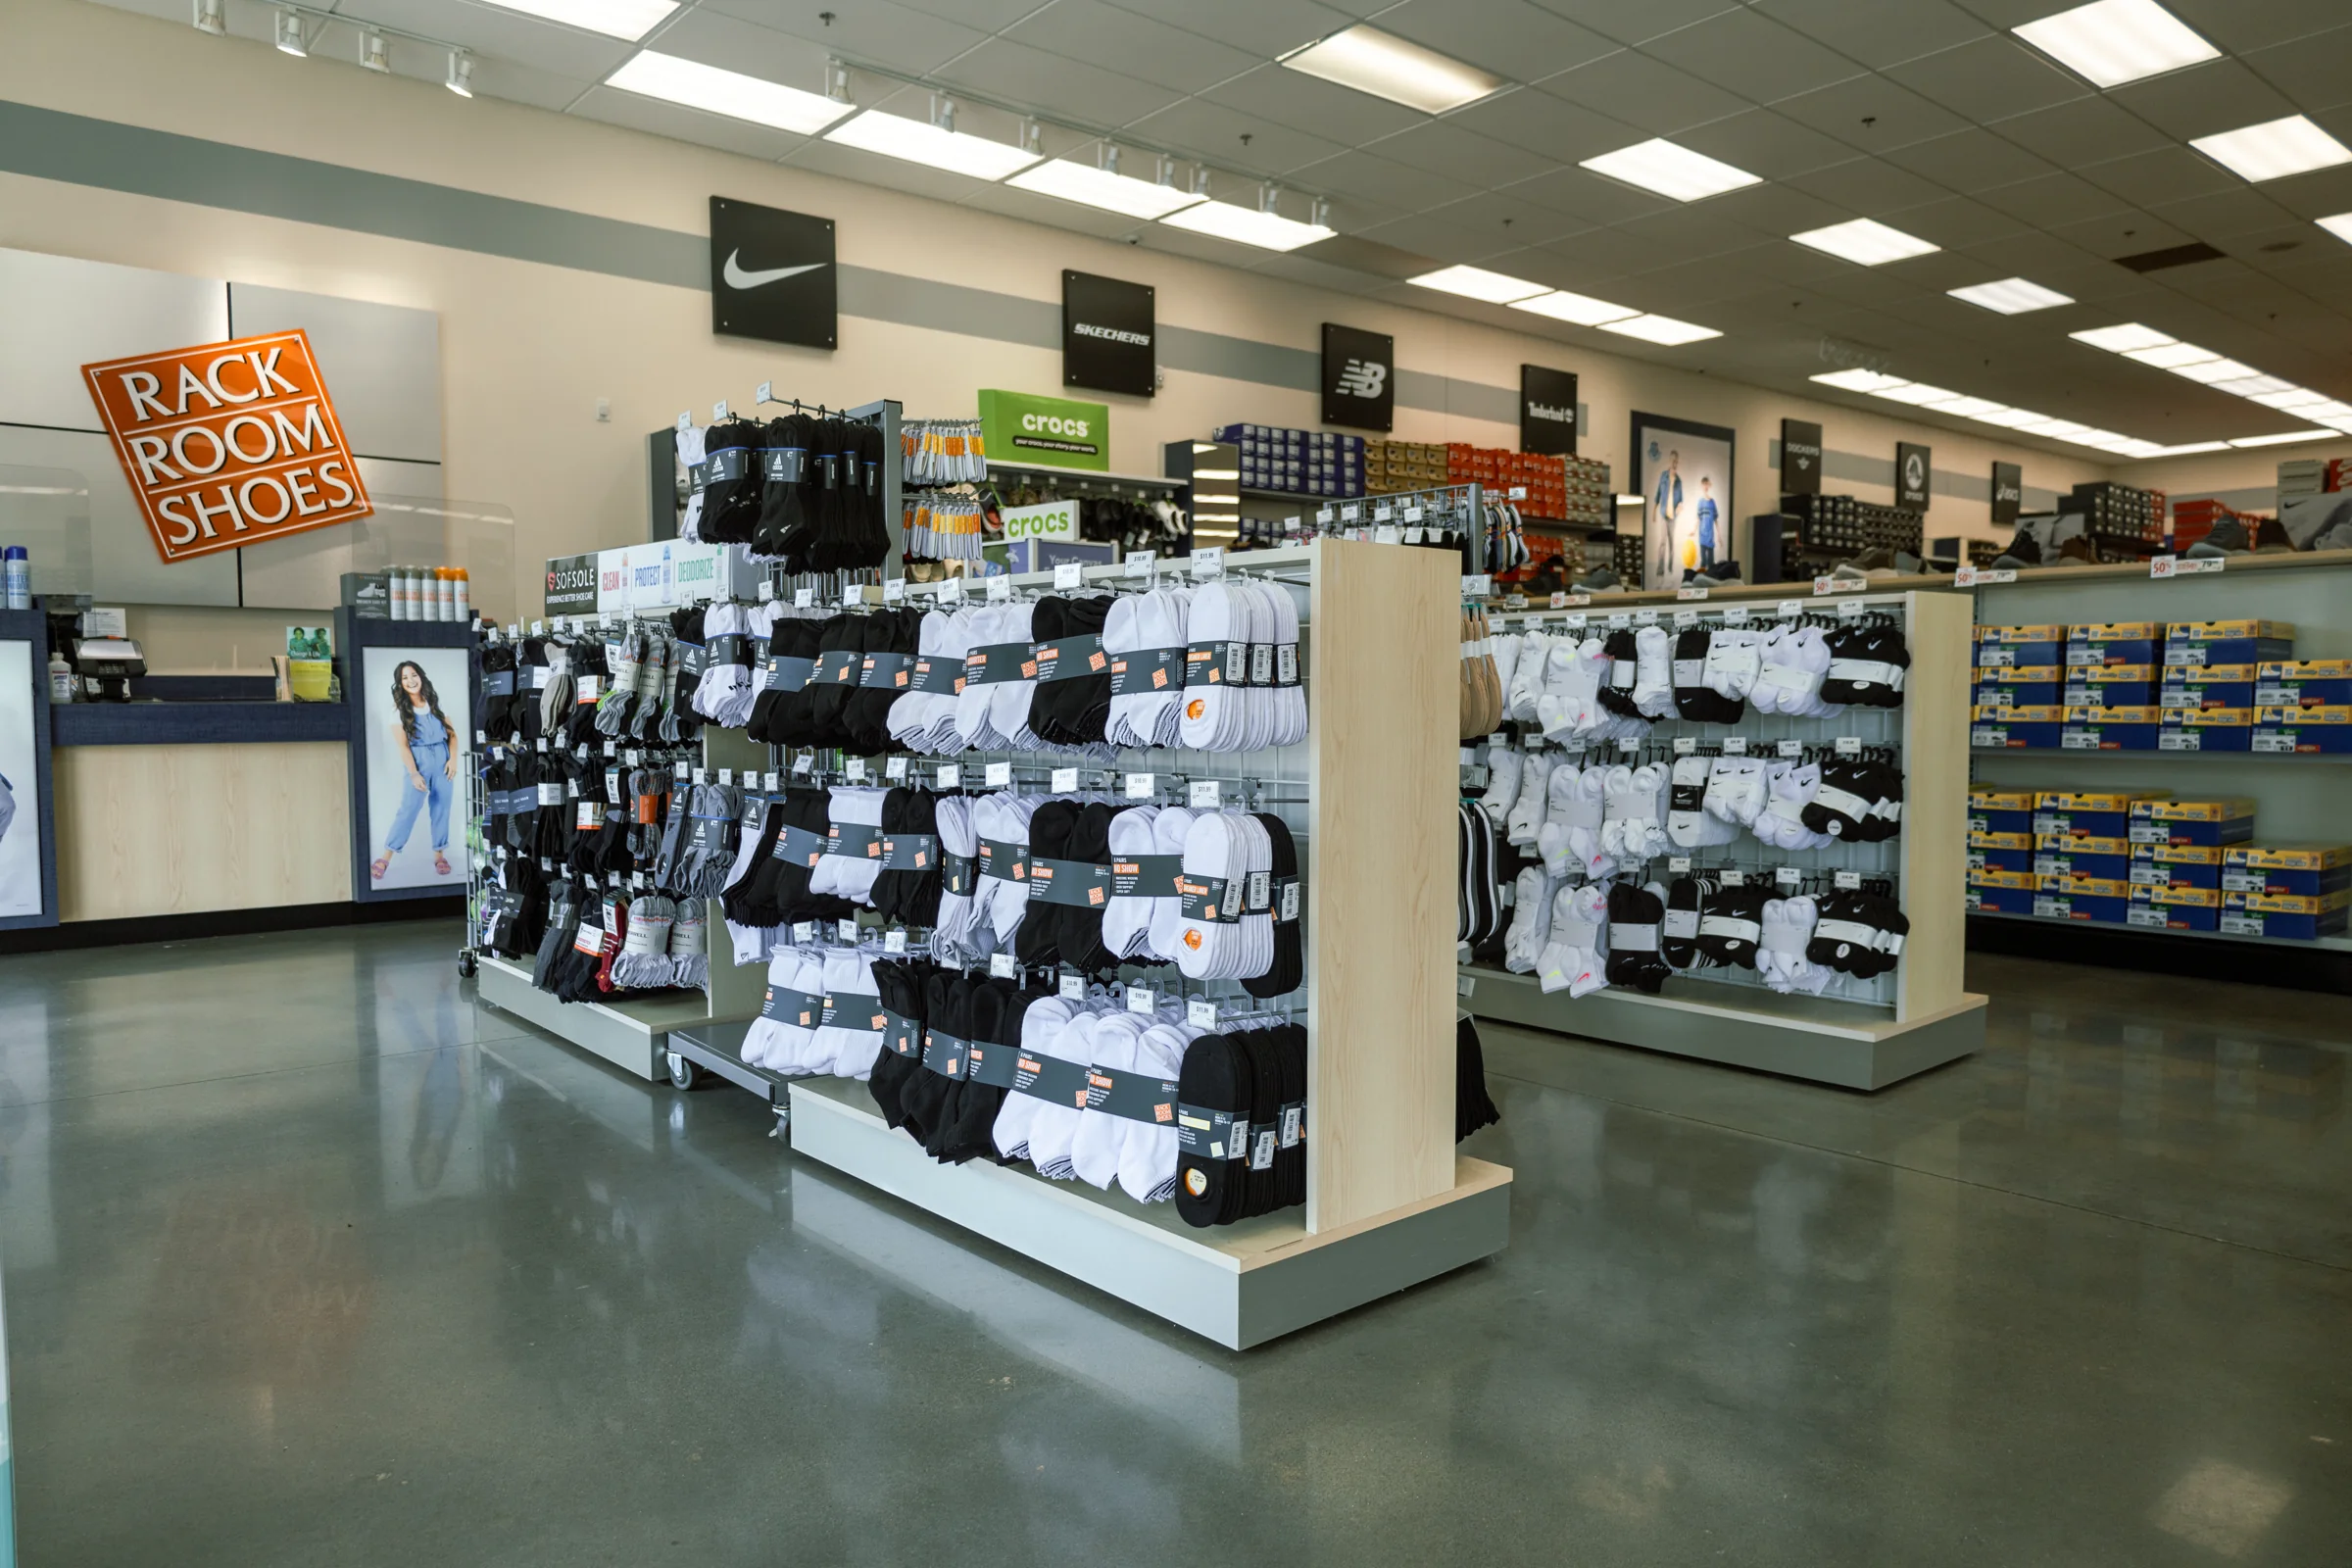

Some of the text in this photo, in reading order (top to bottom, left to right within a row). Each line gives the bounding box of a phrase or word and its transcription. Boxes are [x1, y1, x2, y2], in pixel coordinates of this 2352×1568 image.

[1073, 322, 1151, 346] SKECHERS
[119, 347, 301, 422] RACK
[1528, 402, 1565, 422] Timberland
[1022, 413, 1089, 437] crocs
[127, 403, 335, 486] ROOM
[159, 461, 356, 546] SHOES
[1007, 512, 1069, 537] crocs
[556, 568, 595, 590] SOFSOLE
[603, 570, 619, 591] CLEAN
[635, 565, 661, 588] PROTECT
[678, 558, 714, 583] DEODORIZE
[1044, 650, 1058, 660] SHOW
[1038, 868, 1053, 877] SHOW
[1121, 864, 1138, 873] SHOW
[1025, 1060, 1040, 1072] SHOW
[1096, 1076, 1112, 1088] SHOW
